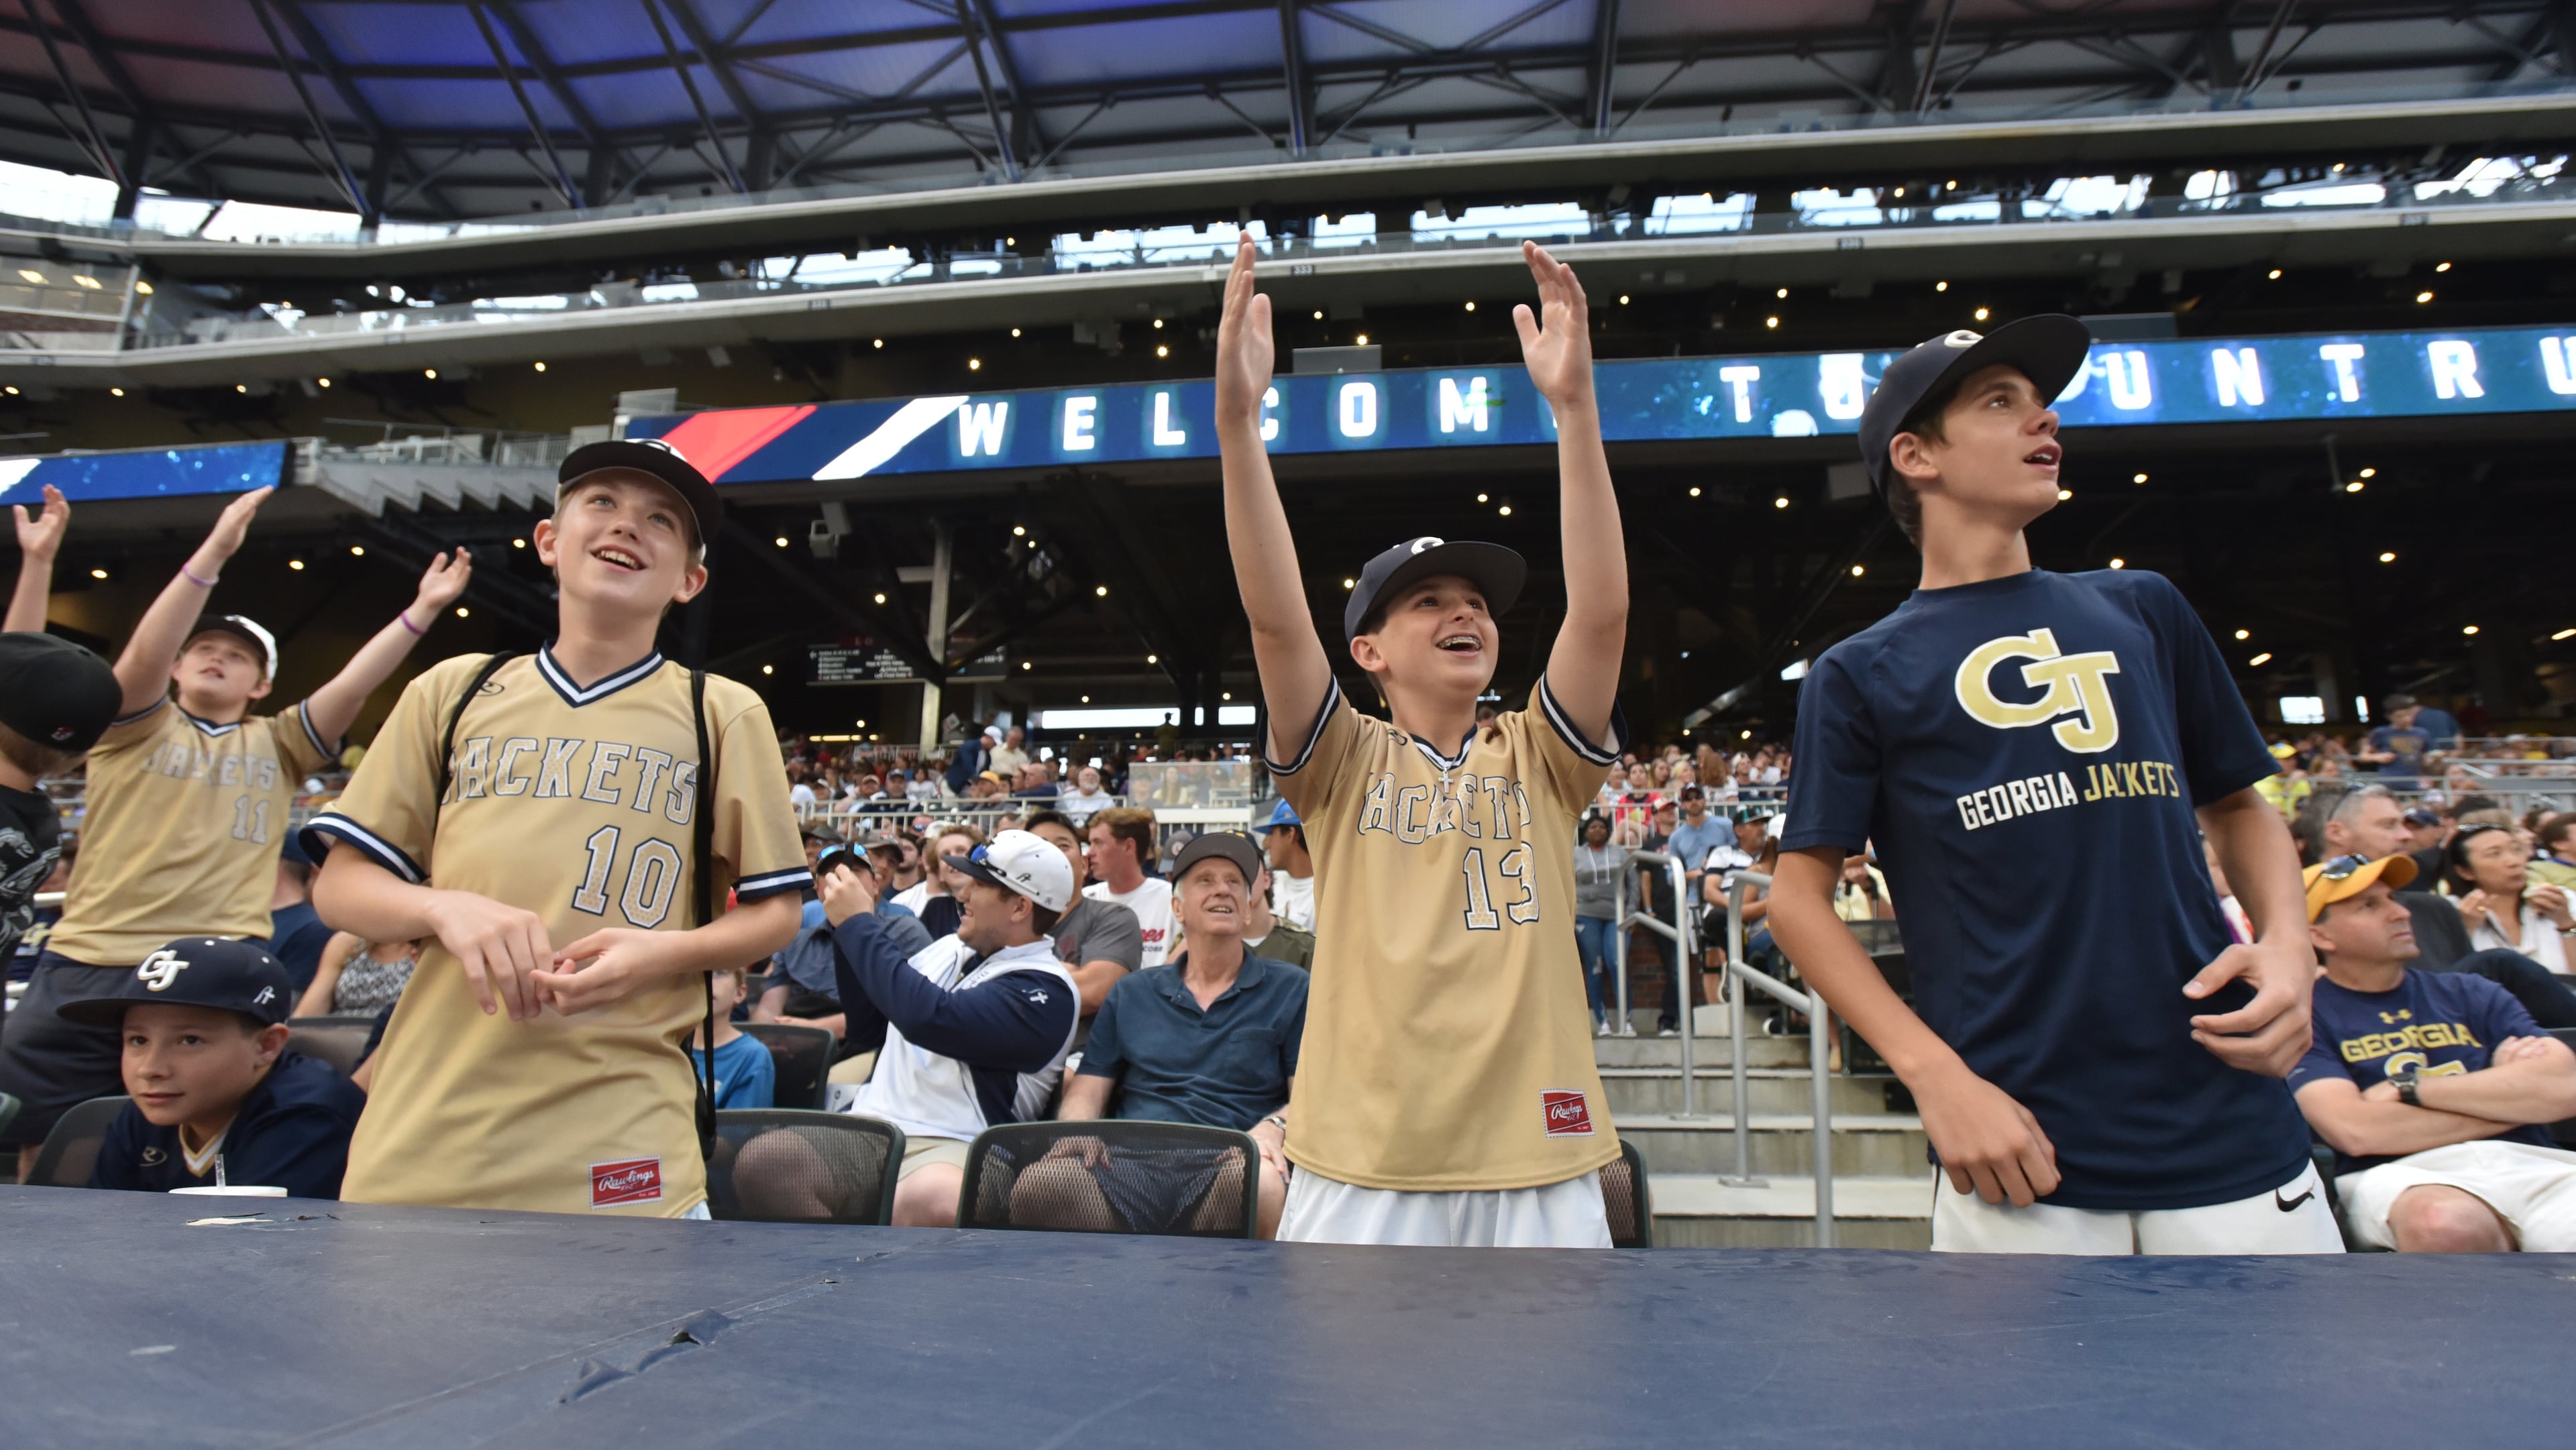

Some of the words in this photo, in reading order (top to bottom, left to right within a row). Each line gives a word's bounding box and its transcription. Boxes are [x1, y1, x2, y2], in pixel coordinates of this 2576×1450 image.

[959, 376, 1558, 457] WELCOM
[2104, 335, 2576, 410] UNTRU
[1955, 627, 2121, 754] GJ
[232, 793, 270, 845] 11
[440, 736, 698, 825] ACKETS
[1358, 771, 1532, 844] ACKET
[1956, 771, 2079, 831] GEORGIA
[572, 824, 682, 930] 10
[1462, 840, 1540, 931] 13
[2339, 1023, 2483, 1064] GEORGIA
[598, 1169, 656, 1192] Rawlings
